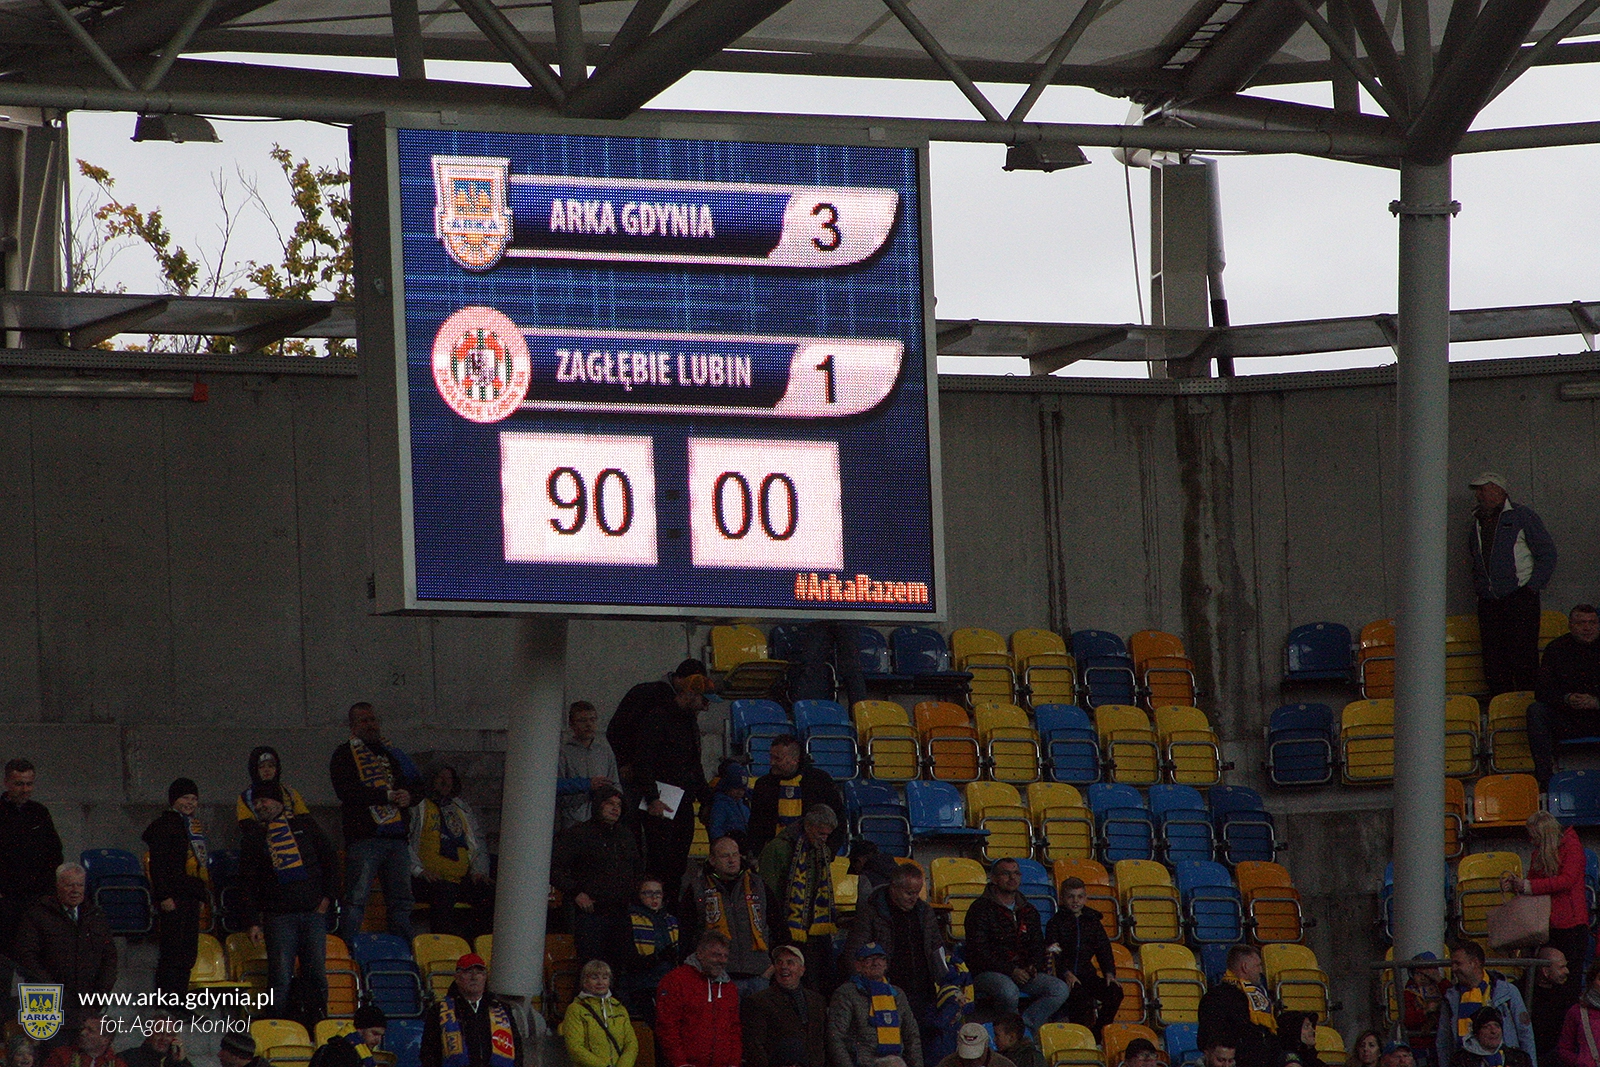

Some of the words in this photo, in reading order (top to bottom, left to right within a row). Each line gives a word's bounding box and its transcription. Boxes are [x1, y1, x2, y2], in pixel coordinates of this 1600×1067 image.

[550, 198, 617, 235] ARKA
[621, 201, 716, 238] GDYNIA
[809, 202, 842, 251] 3
[555, 348, 671, 391] ZAGŁĘBIE
[677, 352, 752, 388] LUBIN
[815, 354, 836, 404] 1
[546, 466, 635, 537] 90
[711, 470, 800, 541] 00
[794, 572, 929, 604] #ArkaRazem
[392, 672, 406, 686] 21
